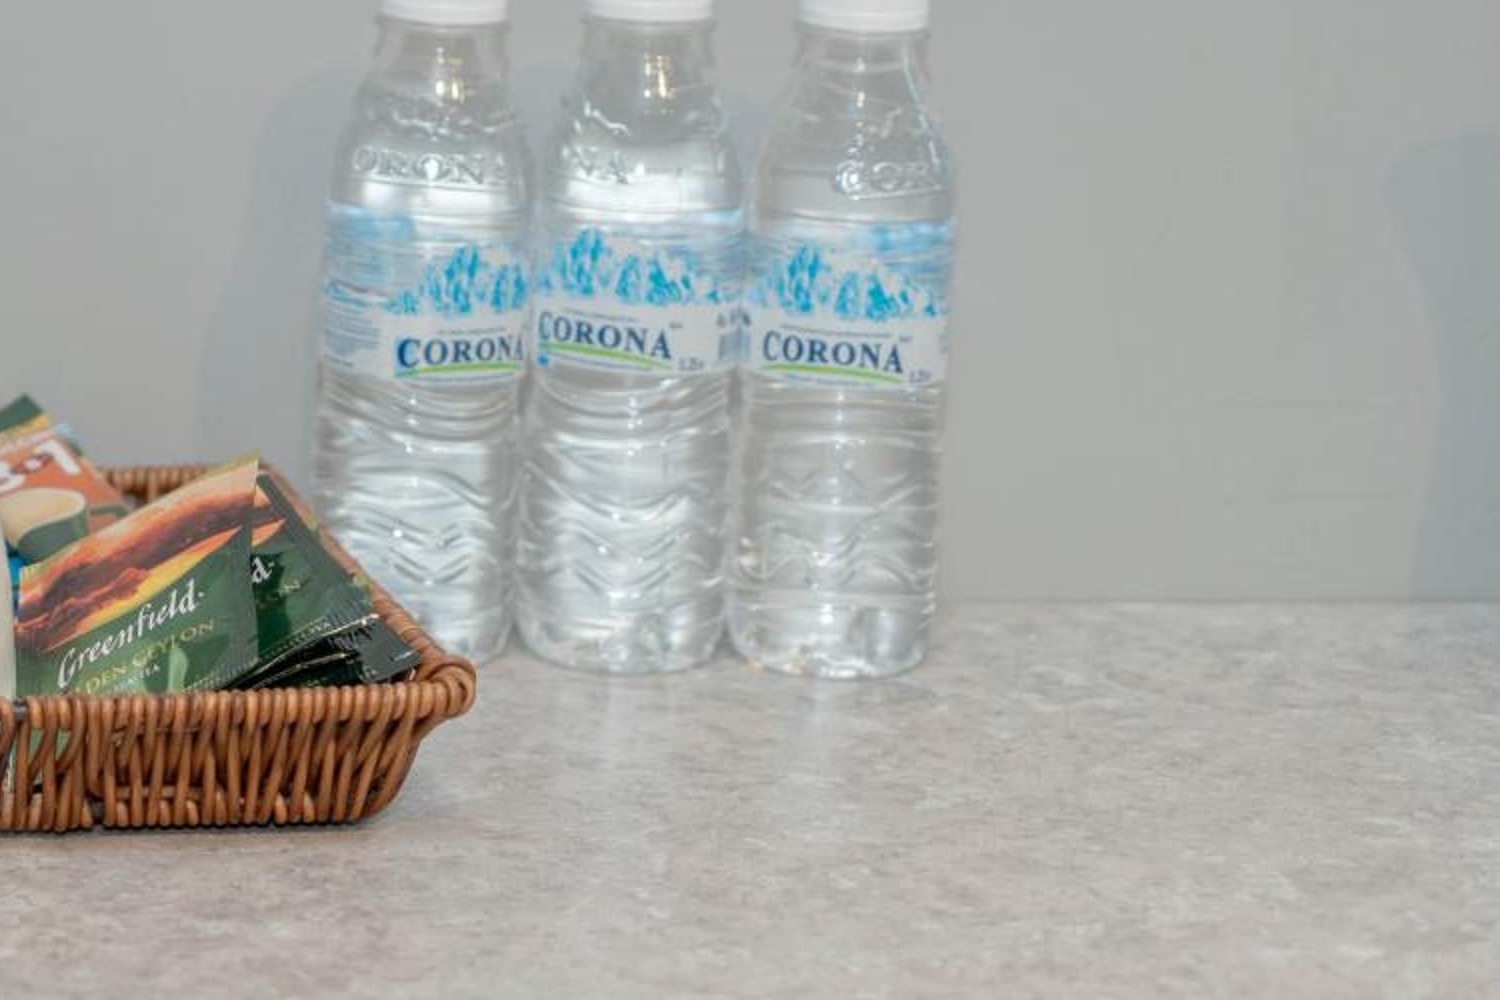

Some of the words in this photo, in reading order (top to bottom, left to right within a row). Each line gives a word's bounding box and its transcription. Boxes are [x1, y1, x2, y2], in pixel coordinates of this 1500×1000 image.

[538, 310, 672, 359] CORONA
[762, 330, 904, 374] CORONA
[57, 577, 197, 689] Greenfield
